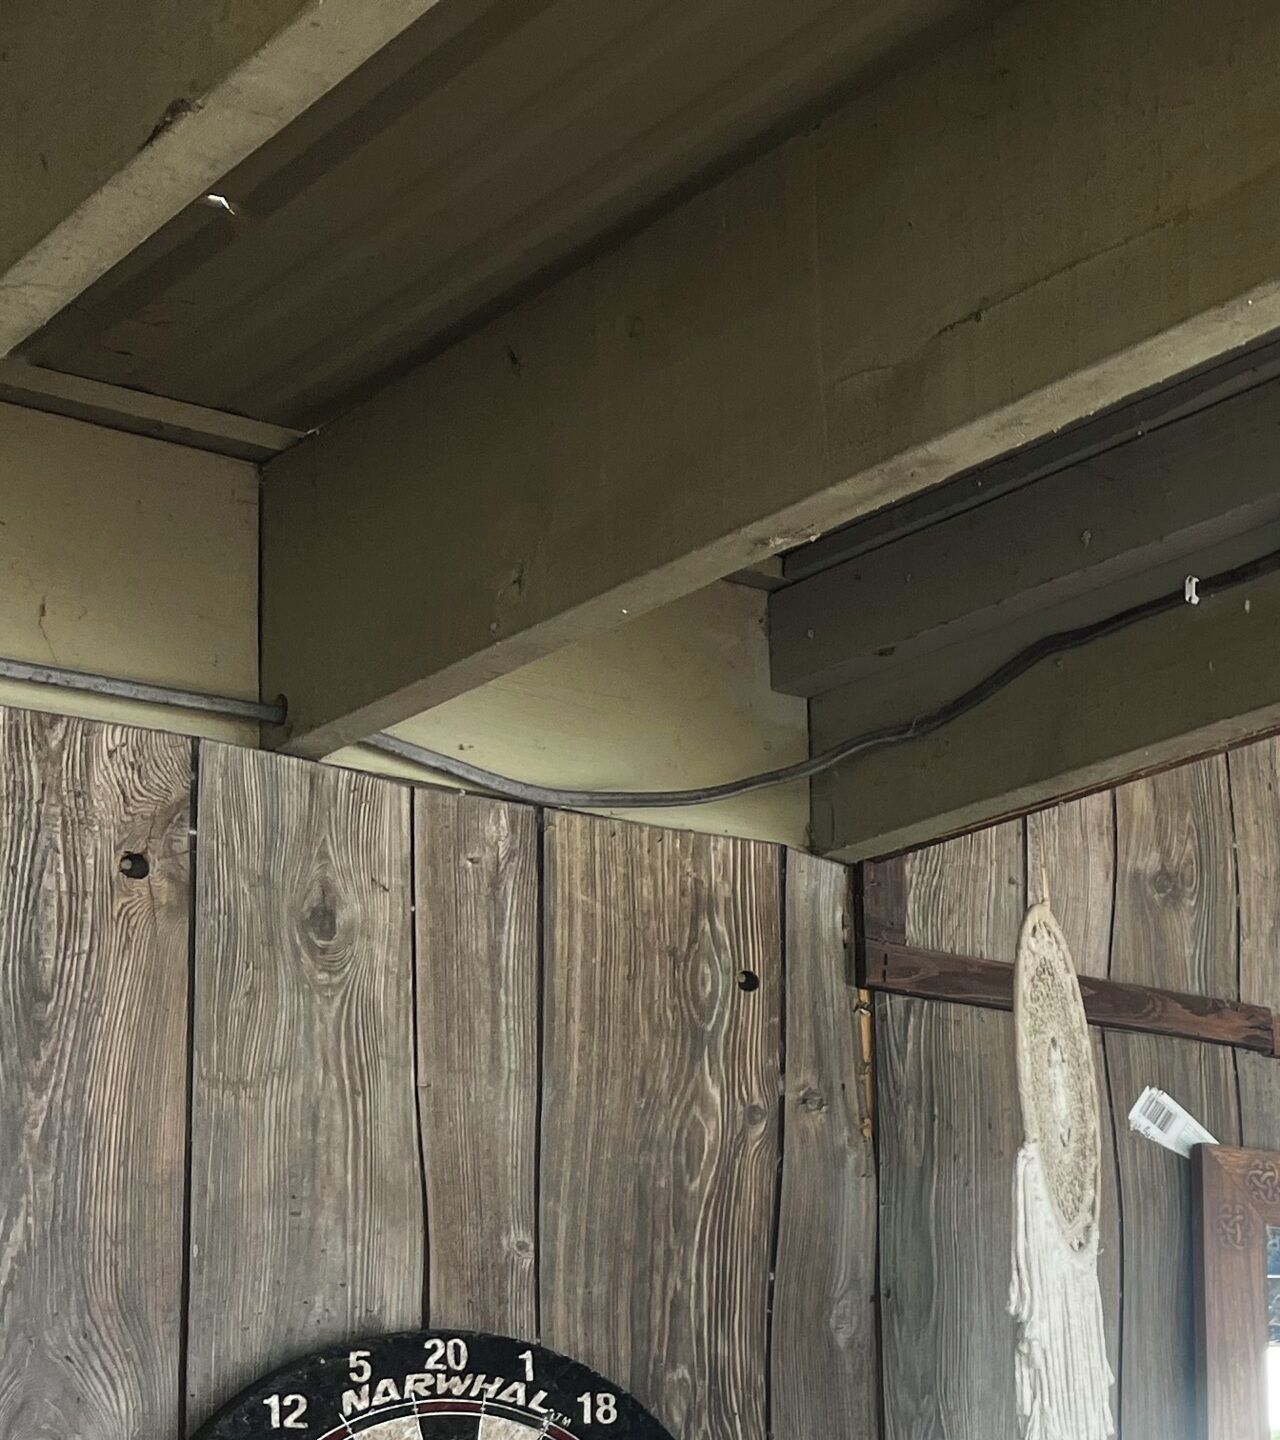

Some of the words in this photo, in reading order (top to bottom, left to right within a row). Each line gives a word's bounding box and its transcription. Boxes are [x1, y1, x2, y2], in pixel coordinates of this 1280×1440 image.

[349, 1350, 372, 1382] 5
[424, 1338, 469, 1371] 20
[518, 1350, 534, 1382] 1
[341, 1372, 554, 1417] NARWHAL
[577, 1393, 618, 1425] 18
[262, 1394, 308, 1429] 12
